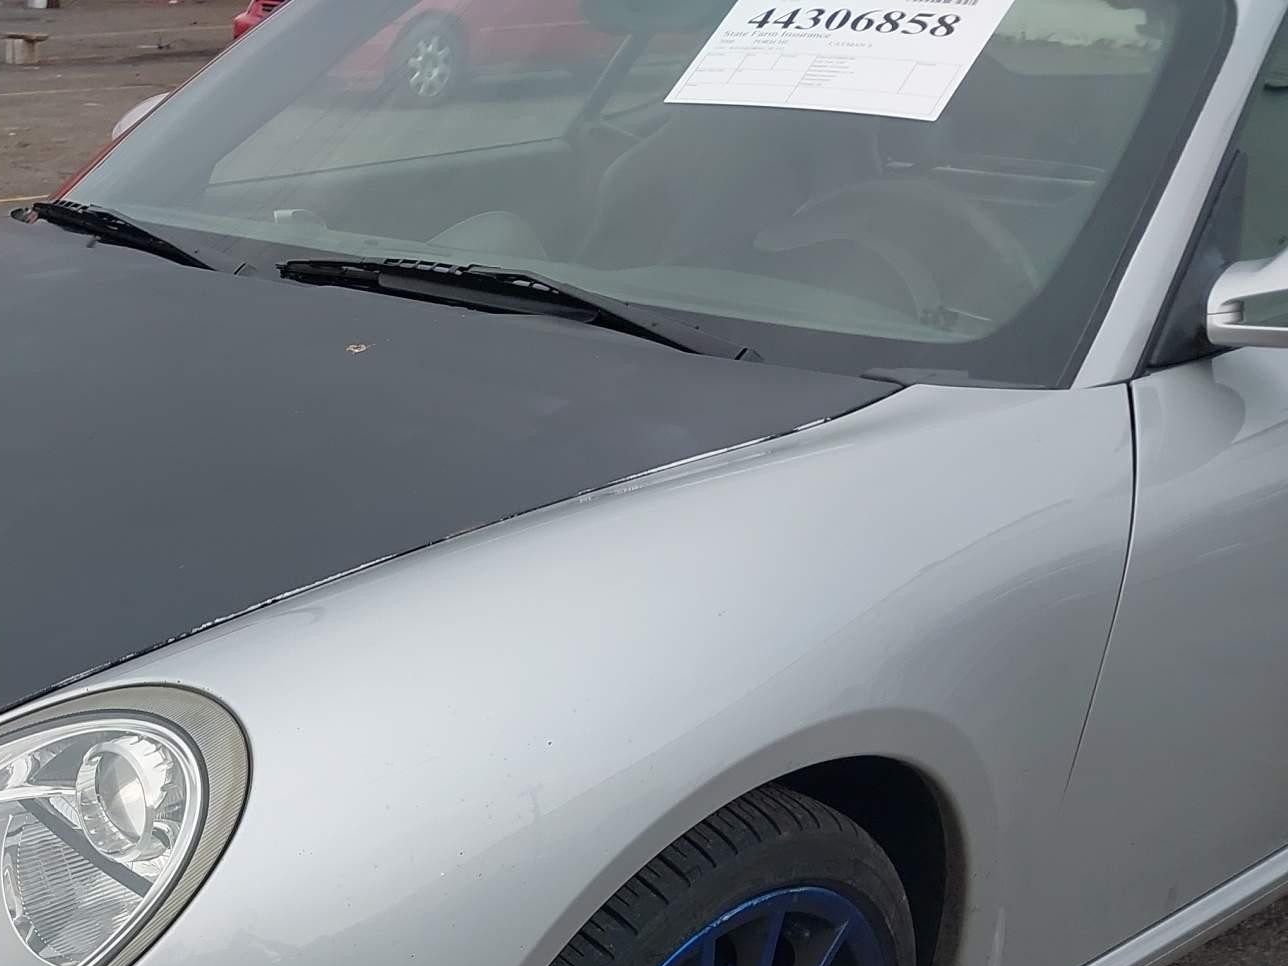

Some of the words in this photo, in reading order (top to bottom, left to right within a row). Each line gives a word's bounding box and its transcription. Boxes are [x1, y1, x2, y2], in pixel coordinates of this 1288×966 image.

[747, 7, 961, 37] 44306858
[724, 30, 750, 38] State
[750, 30, 778, 38] Farm
